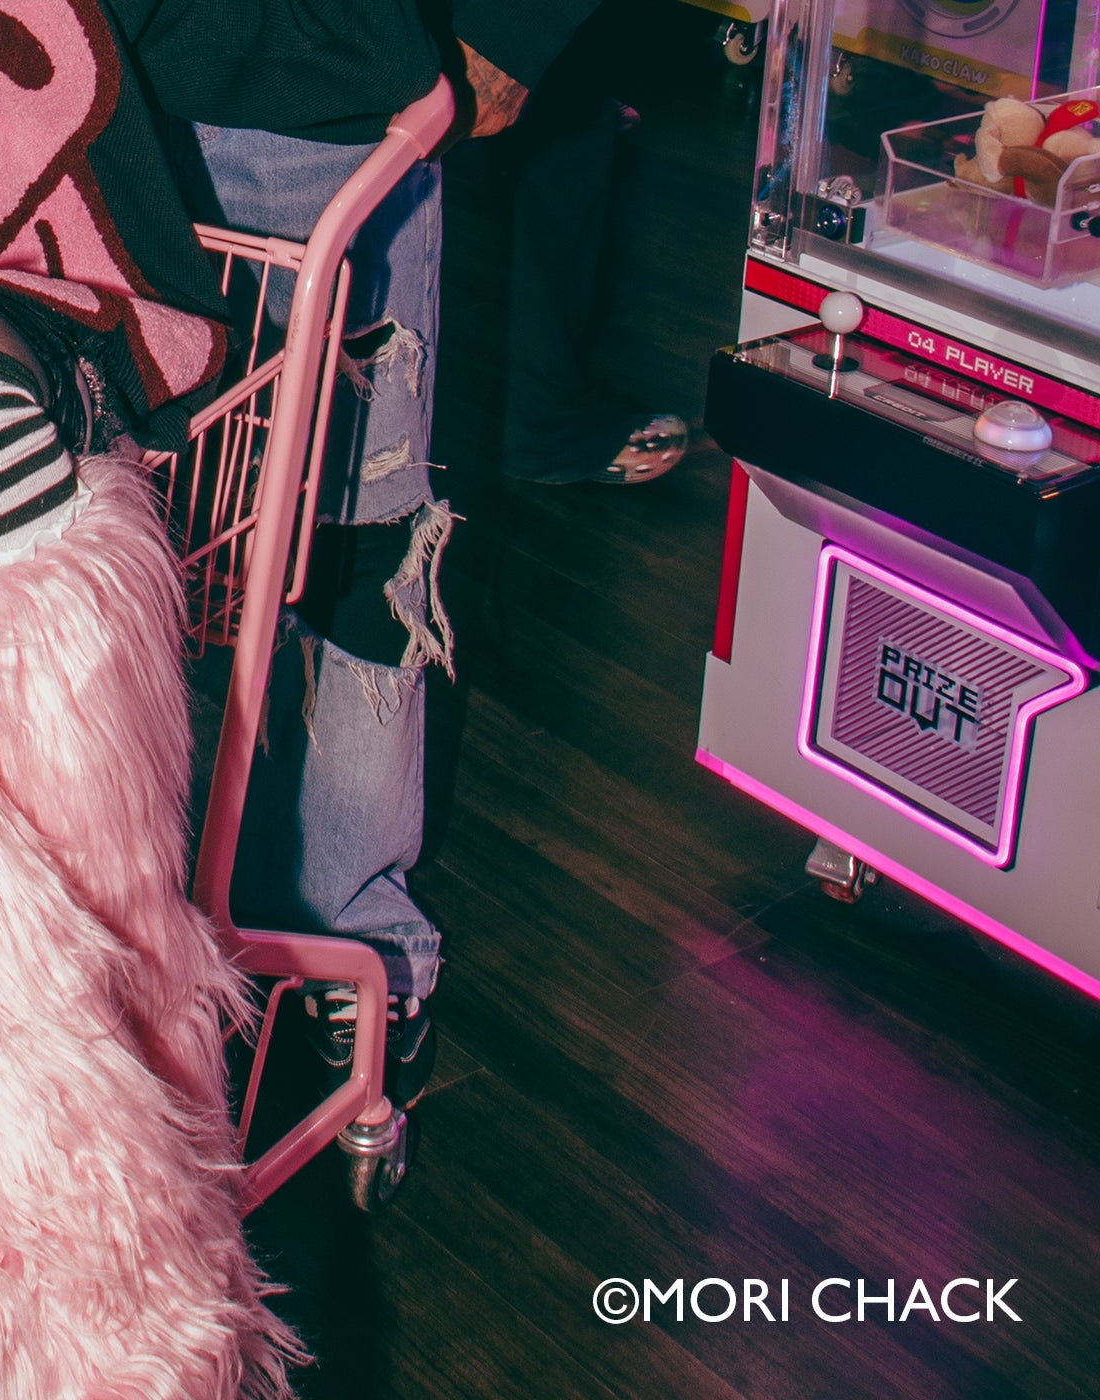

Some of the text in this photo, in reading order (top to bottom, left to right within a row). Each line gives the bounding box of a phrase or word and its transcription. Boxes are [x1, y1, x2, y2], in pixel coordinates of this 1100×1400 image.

[901, 46, 988, 84] KAKO CLAW
[908, 331, 935, 354] 04
[945, 345, 1034, 394] PLAYER
[874, 395, 926, 418] CREDIT
[877, 667, 981, 742] OUT
[881, 644, 979, 713] PRIZE
